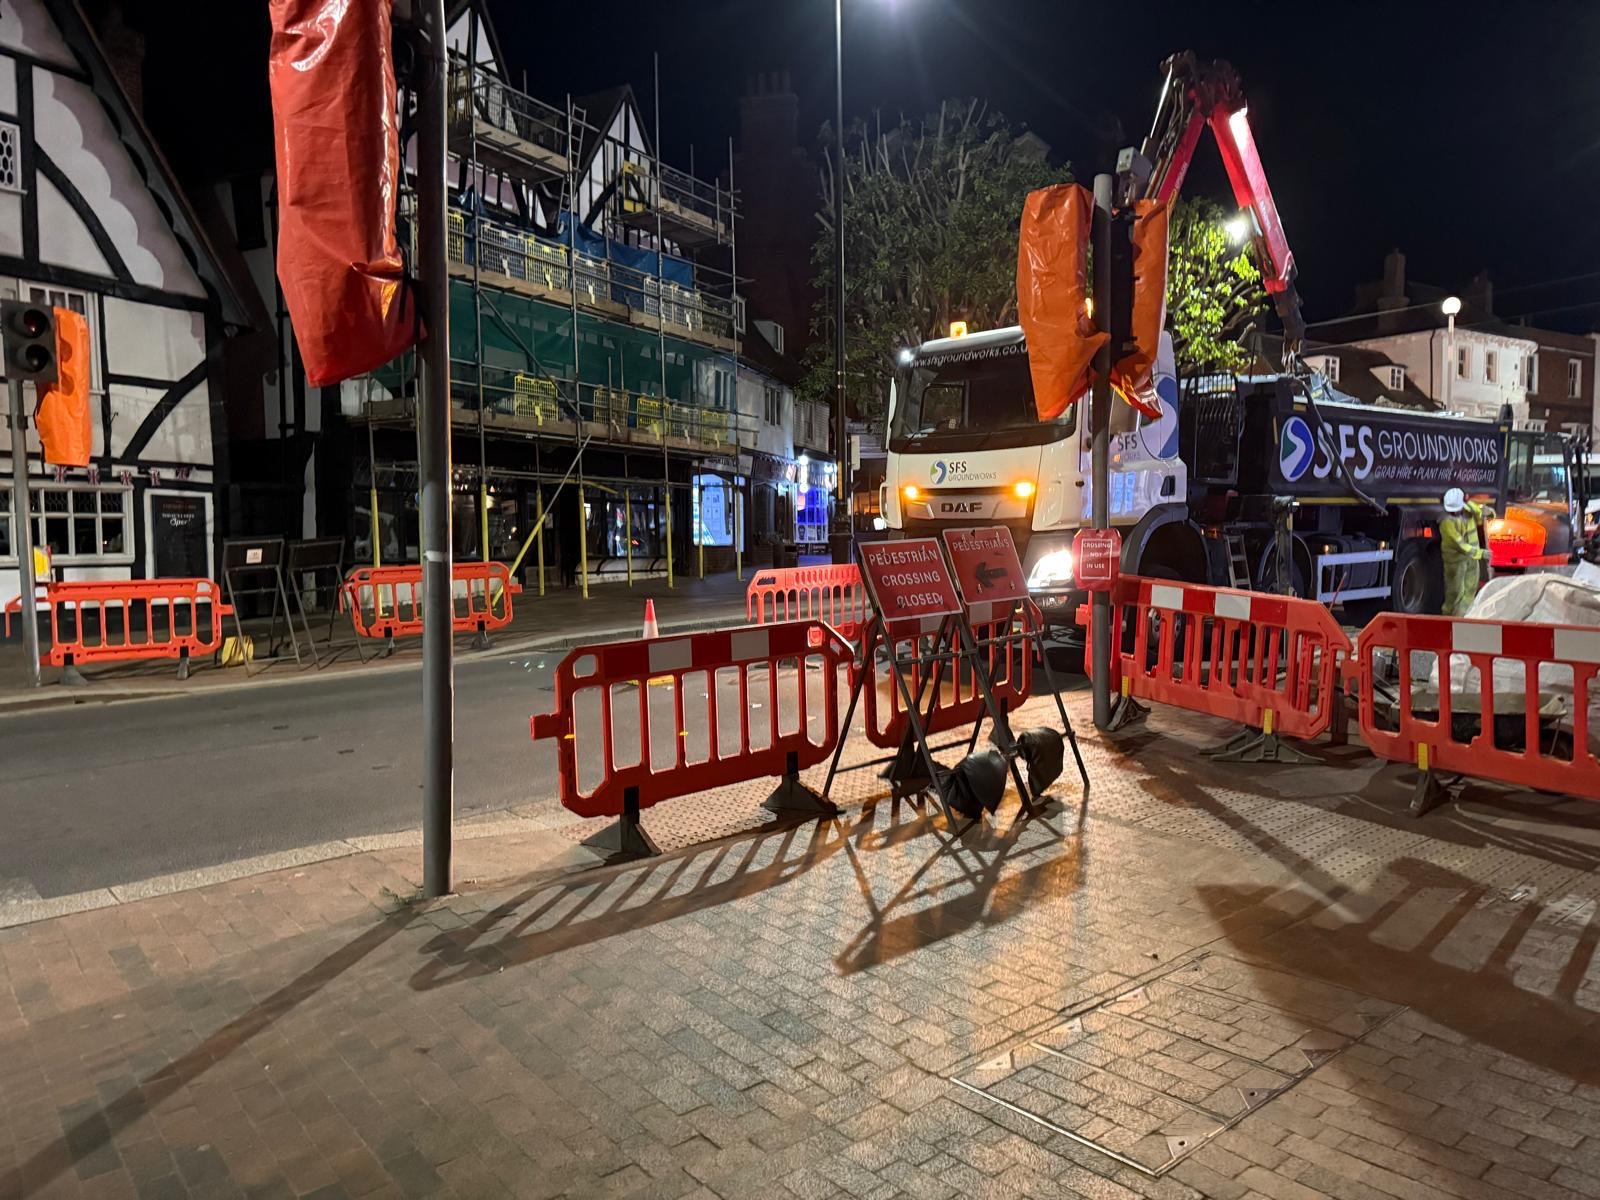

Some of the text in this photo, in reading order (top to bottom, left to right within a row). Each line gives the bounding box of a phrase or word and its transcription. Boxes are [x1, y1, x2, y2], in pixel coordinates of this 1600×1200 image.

[909, 343, 1028, 368] www.sfsgroundworks.co.u
[1118, 433, 1138, 451] SFS
[1313, 422, 1375, 479] SFS
[1378, 430, 1498, 465] GROUNDWORKS
[949, 461, 967, 474] SFS
[1374, 465, 1497, 483] GRAB HIRE PLANT HIRE AGGREGATES
[948, 472, 997, 481] GROUNDWORKS
[941, 502, 982, 513] DAF
[953, 538, 1010, 551] PEDESTRIANS
[868, 549, 938, 566] PEDESTRIAN
[882, 570, 941, 587] CROSSING
[897, 592, 942, 608] CLOSED
